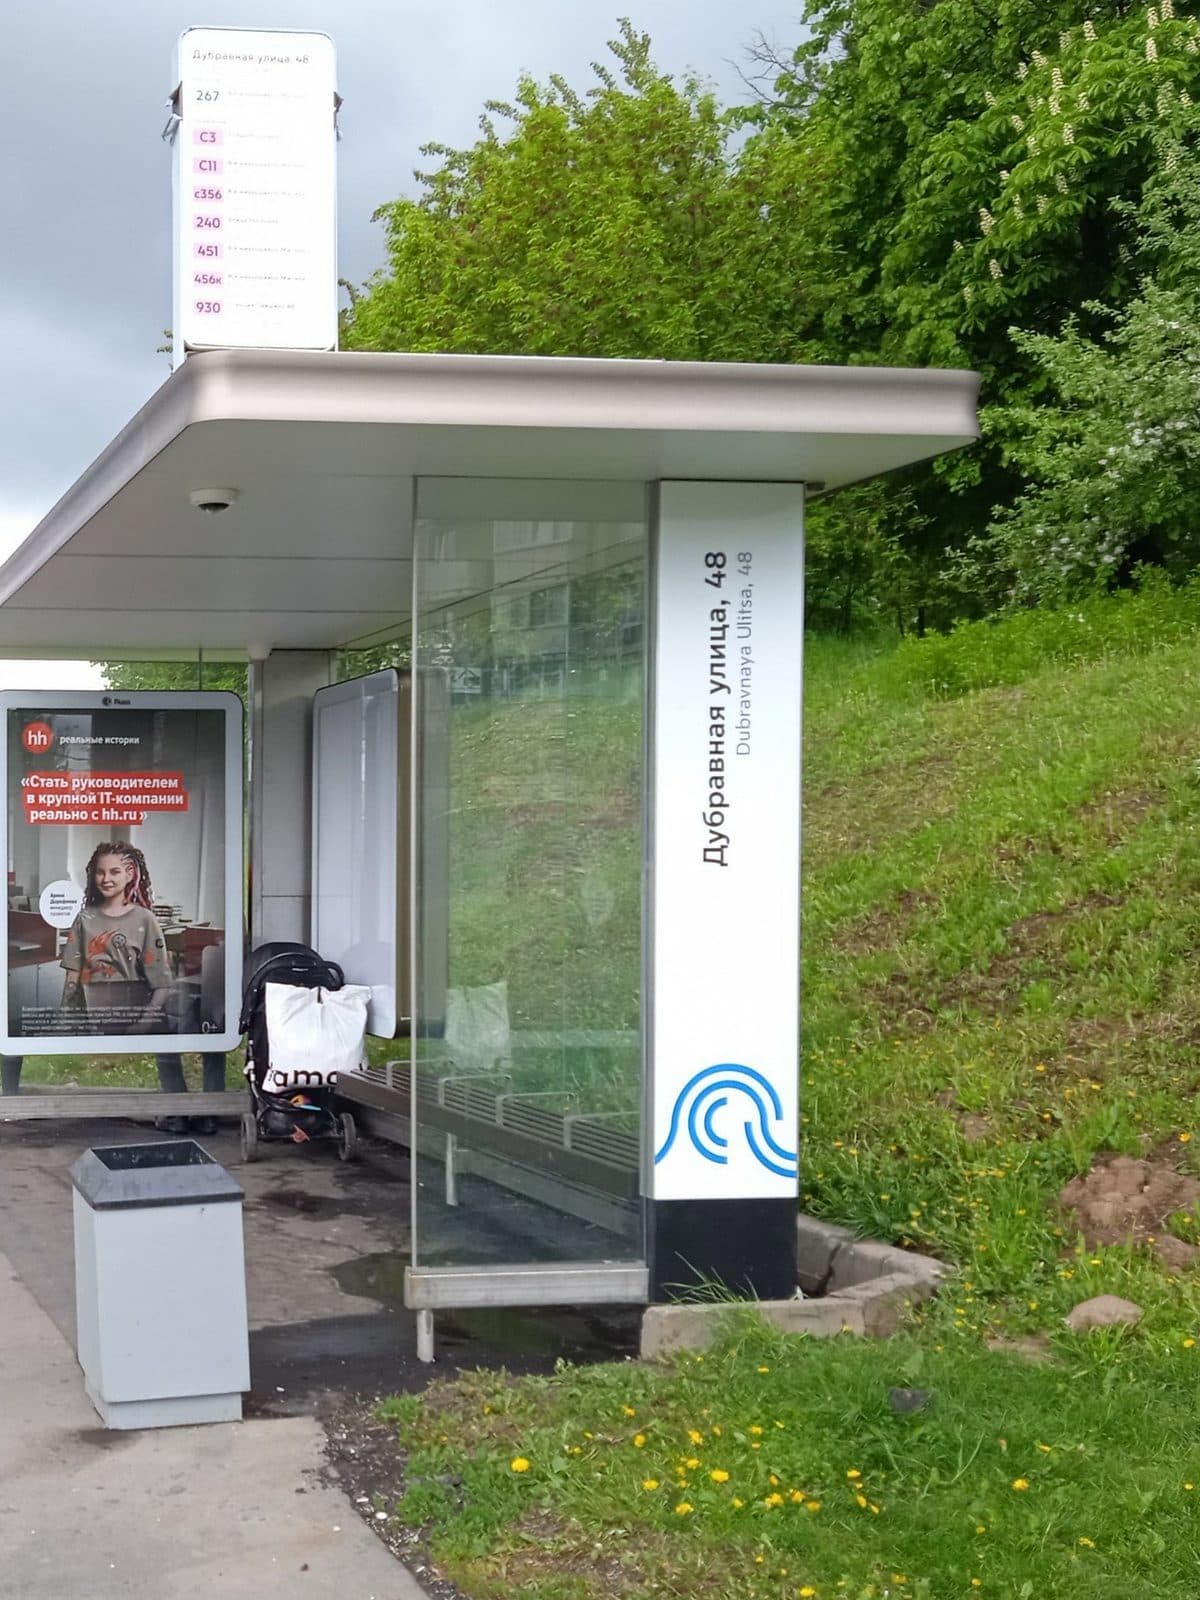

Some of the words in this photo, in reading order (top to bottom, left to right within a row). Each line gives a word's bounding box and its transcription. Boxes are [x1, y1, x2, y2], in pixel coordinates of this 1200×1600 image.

[196, 90, 220, 102] 267
[199, 131, 217, 143] С3
[194, 188, 222, 200] с356
[196, 216, 221, 229] 240
[197, 245, 219, 257] 451
[194, 274, 222, 285] 456к
[196, 302, 221, 314] 930
[704, 551, 727, 589] 48
[737, 552, 753, 577] 48
[736, 584, 754, 640] Ulitsa,
[709, 600, 732, 695] улица,
[735, 645, 755, 757] Dubravnaya
[28, 731, 48, 745] hh
[59, 736, 103, 745] реальные
[105, 736, 140, 745] истории
[21, 775, 68, 788] «Стать
[72, 777, 178, 790] руководителем
[702, 706, 730, 867] Дубравная
[27, 793, 34, 804] в
[39, 792, 97, 807] крупной
[100, 792, 184, 805] IT-компании
[30, 809, 88, 823] реально
[91, 812, 99, 820] с
